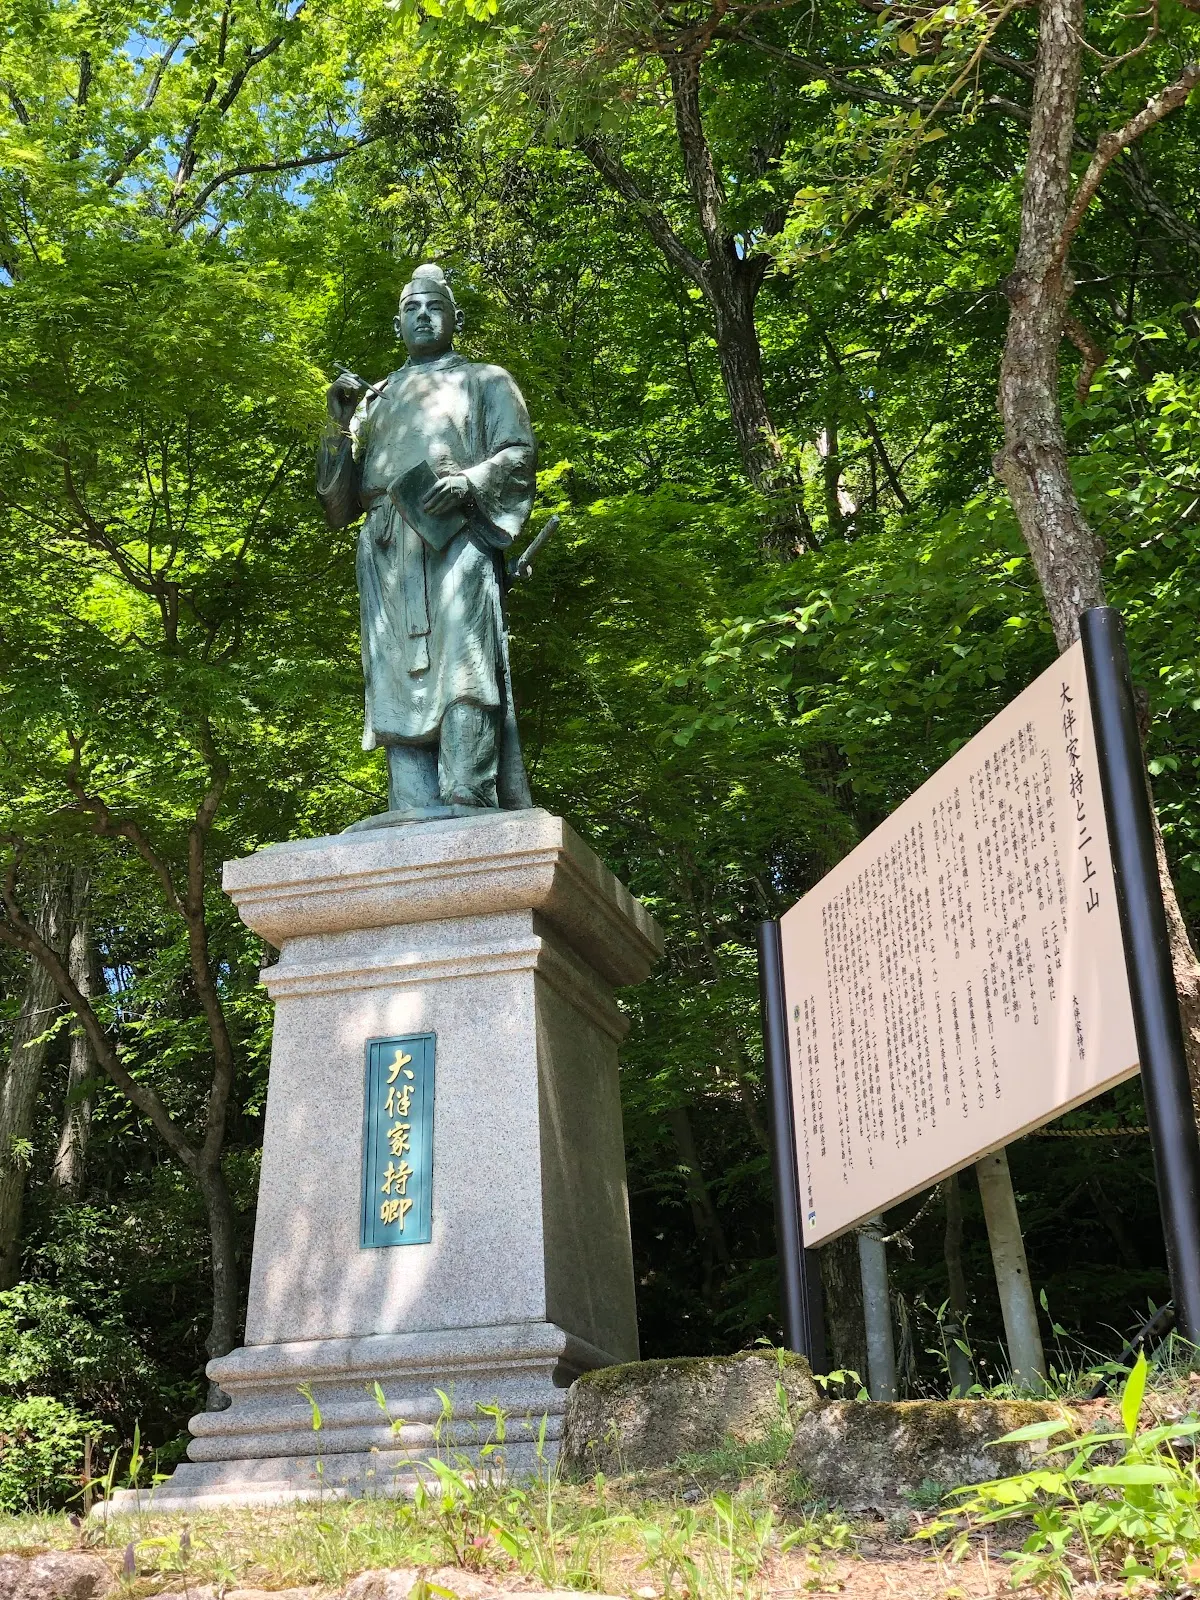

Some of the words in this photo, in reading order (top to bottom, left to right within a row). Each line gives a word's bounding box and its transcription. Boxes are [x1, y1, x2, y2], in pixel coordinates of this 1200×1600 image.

[1059, 681, 1100, 914] 大伴家持と二上山
[1050, 920, 1062, 970] 二上山は
[380, 1049, 415, 1235] 大伴家持卿
